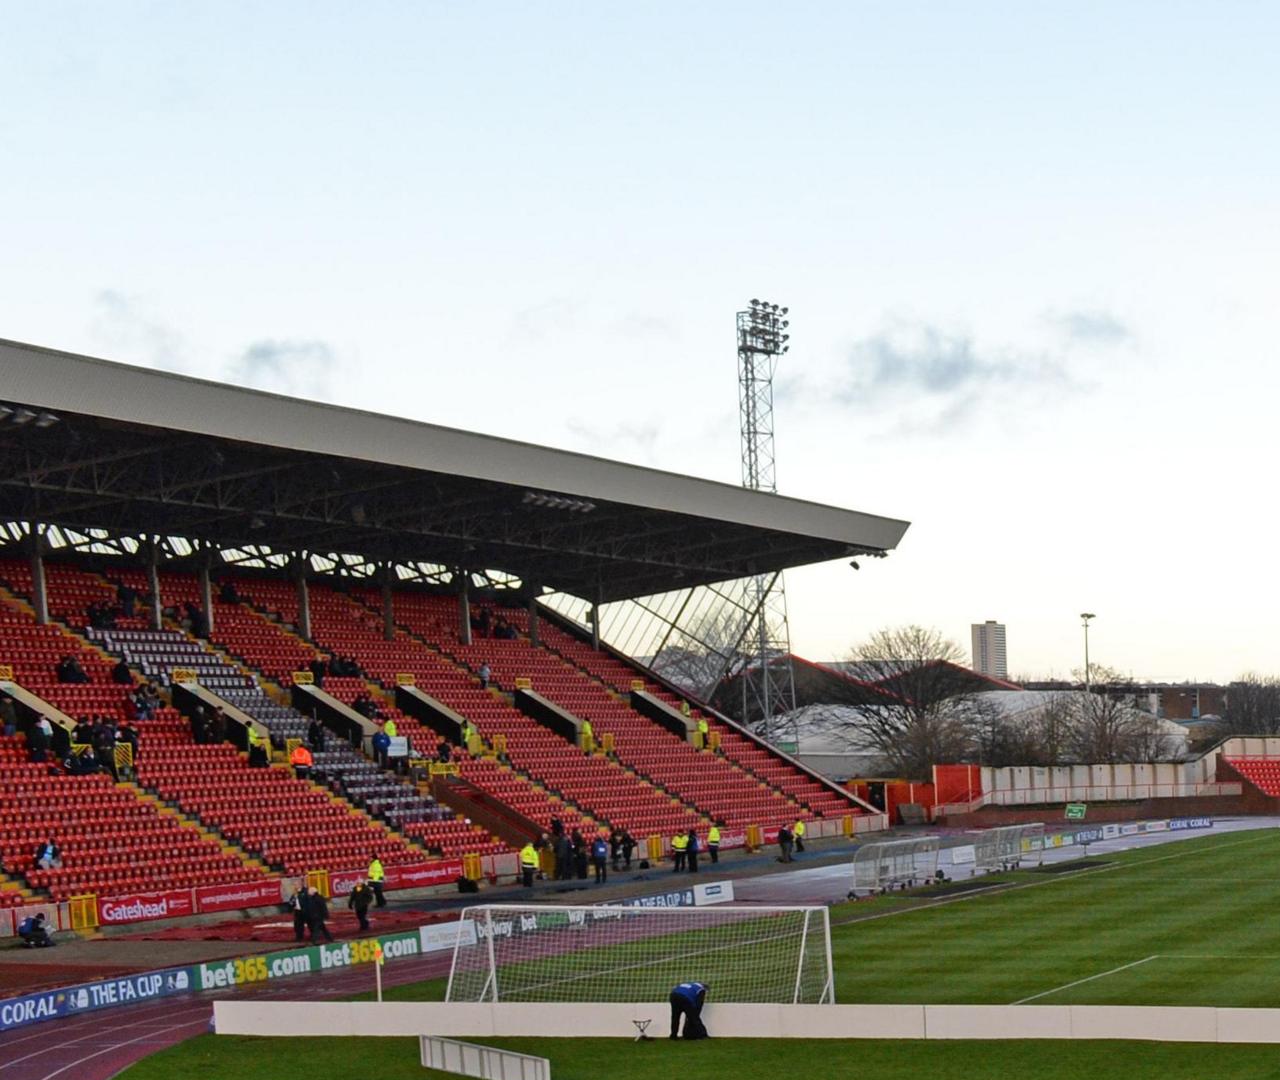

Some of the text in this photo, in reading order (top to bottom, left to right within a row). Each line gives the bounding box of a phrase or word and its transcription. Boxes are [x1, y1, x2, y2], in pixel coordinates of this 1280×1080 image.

[102, 898, 168, 921] Gateshead
[200, 953, 310, 989] bet365.com
[91, 975, 162, 1006] THE FA CUP
[2, 995, 58, 1025] CORAL
